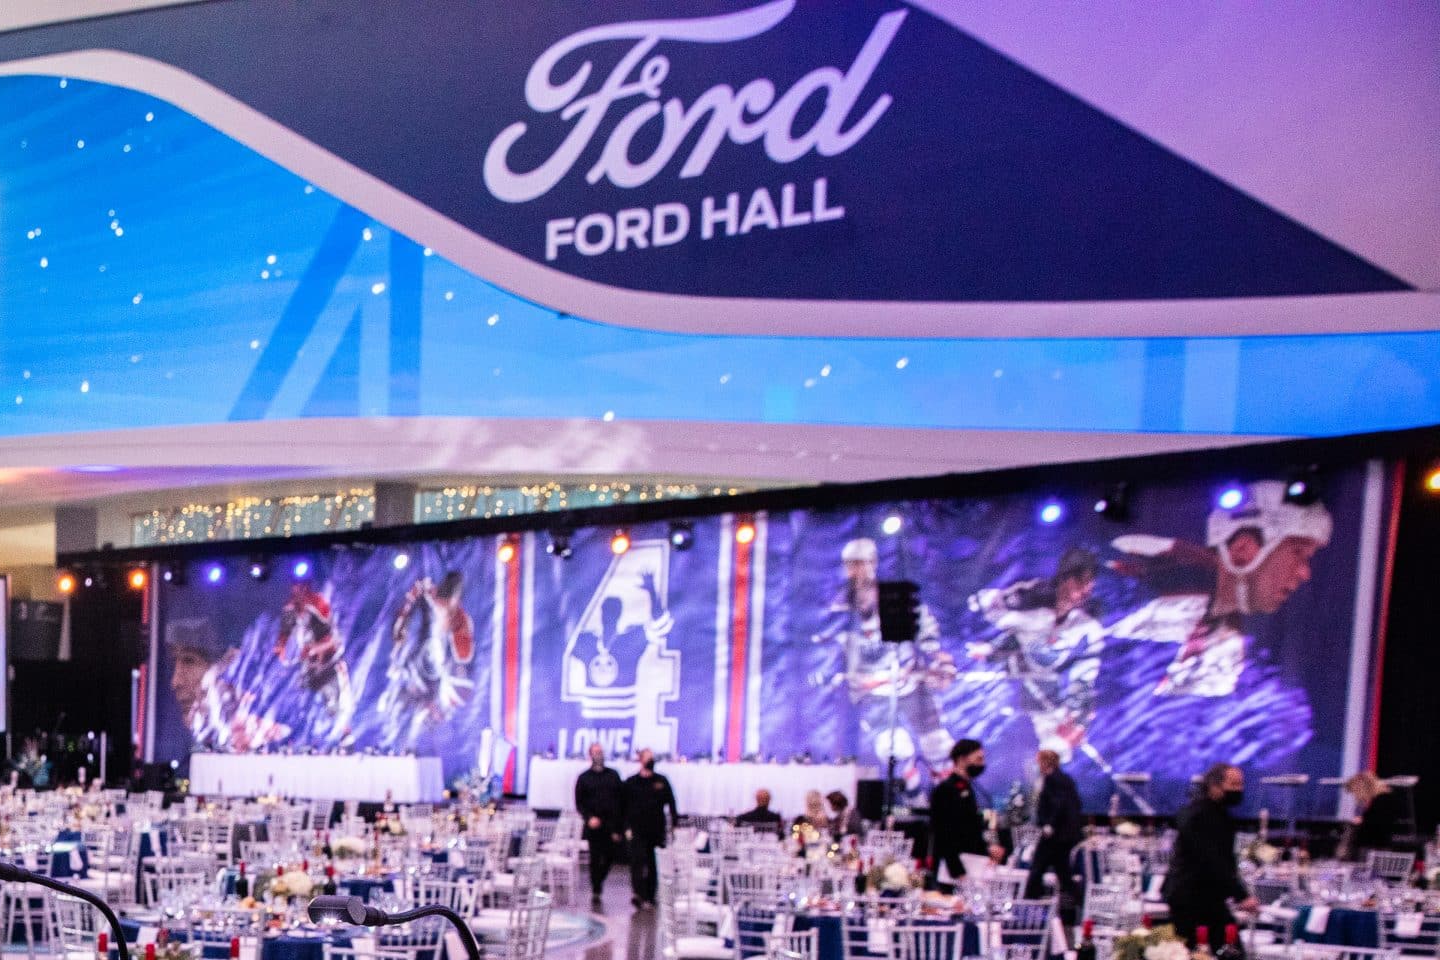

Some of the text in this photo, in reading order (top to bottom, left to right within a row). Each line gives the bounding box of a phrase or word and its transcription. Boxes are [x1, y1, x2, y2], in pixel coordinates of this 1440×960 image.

[483, 0, 908, 202] Ford
[545, 178, 845, 260] FORD HALL
